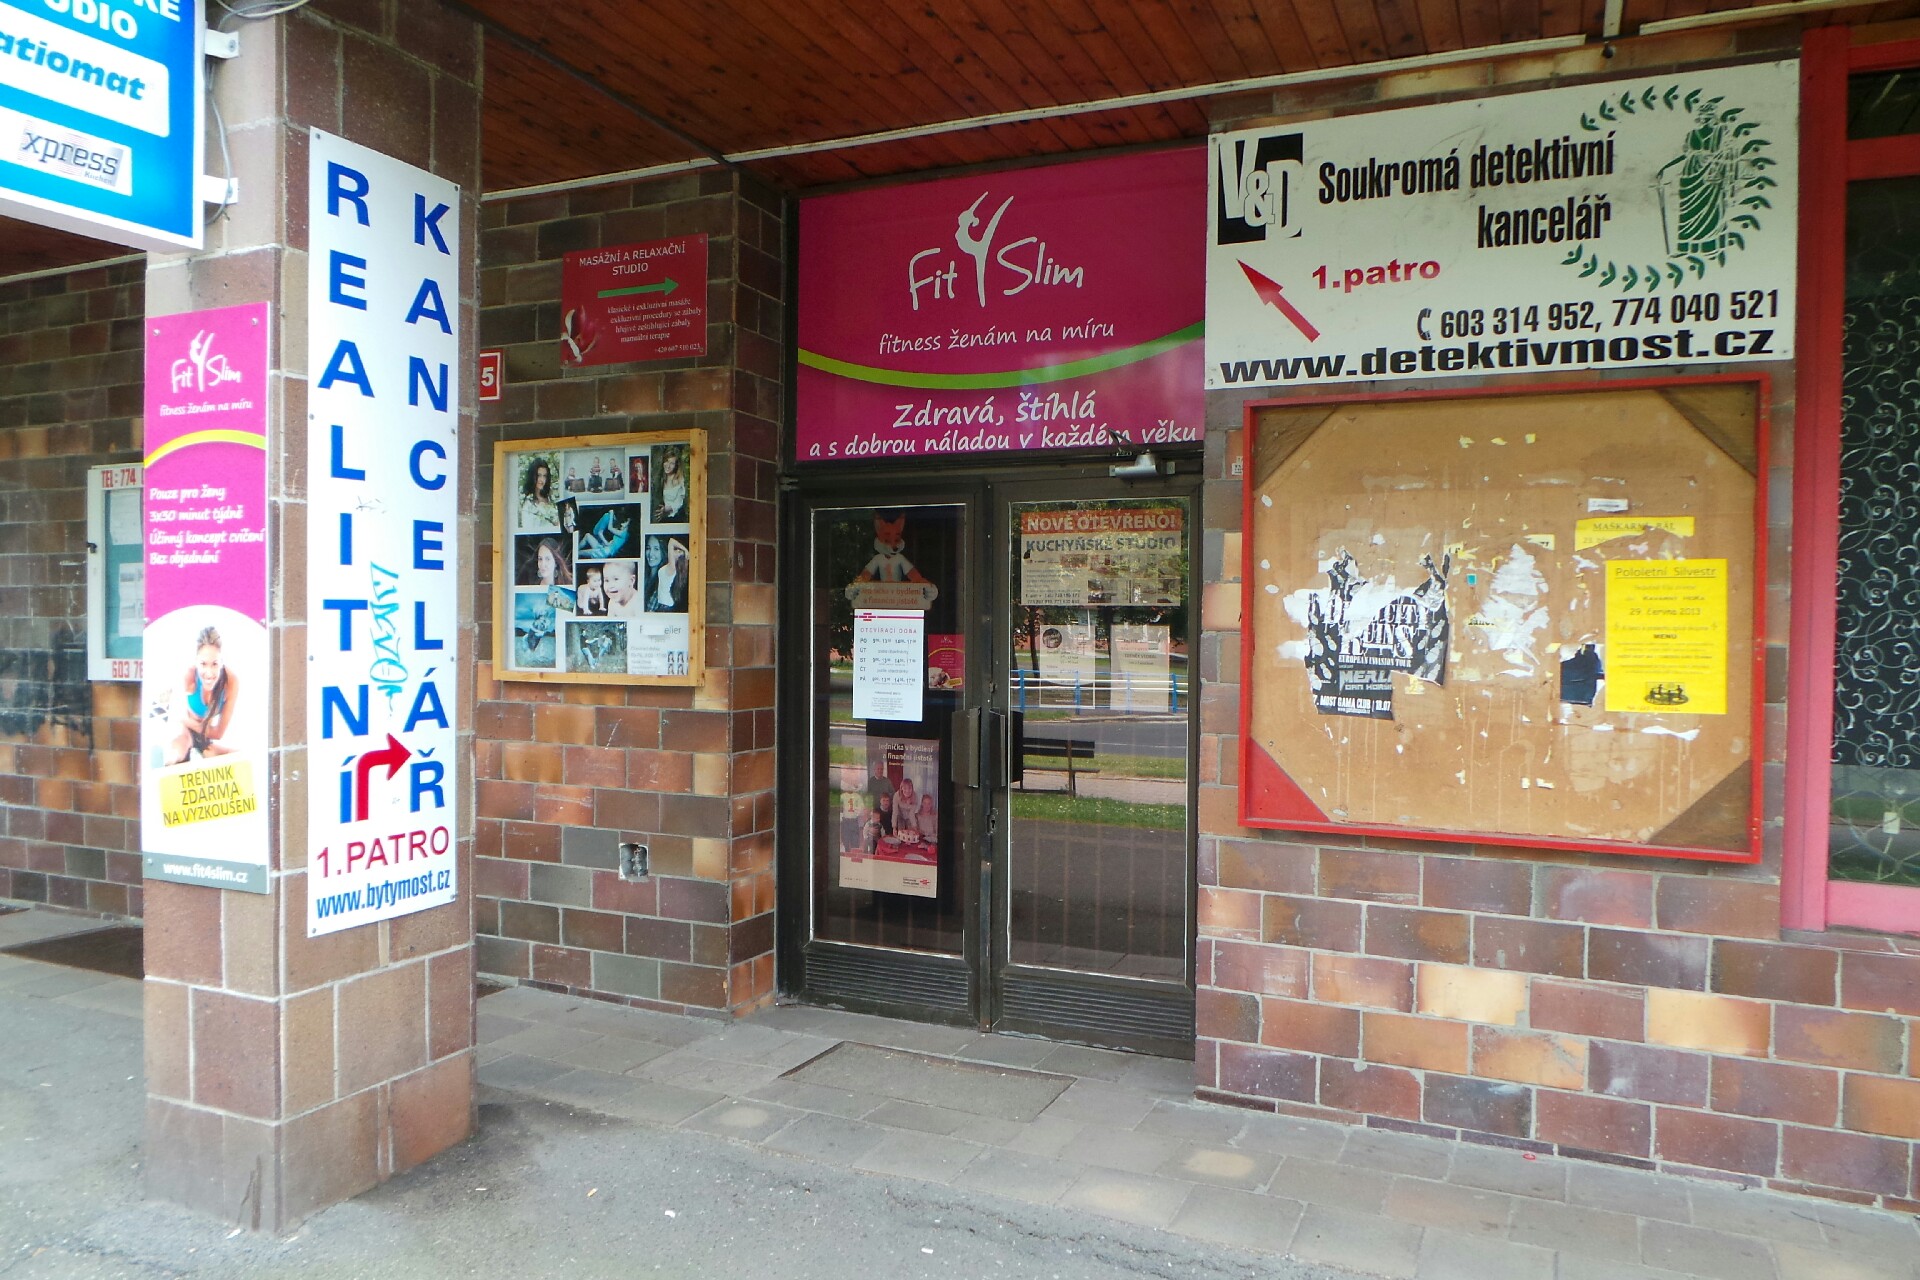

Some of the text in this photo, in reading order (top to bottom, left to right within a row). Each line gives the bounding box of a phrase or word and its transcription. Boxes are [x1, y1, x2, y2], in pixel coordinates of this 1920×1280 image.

[22, 131, 119, 175] xpress
[1318, 130, 1616, 205] Soukromá detektivní
[1477, 193, 1612, 249] kancelář
[579, 240, 686, 267] MASÁŽNÍ A RELAXAČNÍ
[612, 262, 649, 276] STUDIO
[908, 236, 1085, 311] Fit Slim
[1312, 258, 1441, 294] 1.patro
[1441, 288, 1779, 339] 603 314 952, 774 040 521
[878, 317, 1115, 355] fitness ženám na míru
[1219, 329, 1775, 384] www.detektivmost.cz
[892, 389, 1096, 429] Zdravá, štíhlá
[809, 418, 1197, 458] a s dobrou náladou v každém věku
[149, 487, 179, 500] Pouze
[317, 159, 375, 823] REALITNÍ
[403, 192, 453, 813] KANCELÁŘ
[178, 507, 211, 520] minut
[1077, 512, 1176, 530] OTEVŘENO!
[1616, 566, 1718, 577] Pololetní Silvestr
[180, 781, 240, 806] ZDARMA
[163, 811, 180, 826] NA
[316, 825, 451, 879] 1.PATRO
[163, 862, 248, 884] www.fit4slim.cz
[316, 867, 451, 919] www.bytymost.cz
